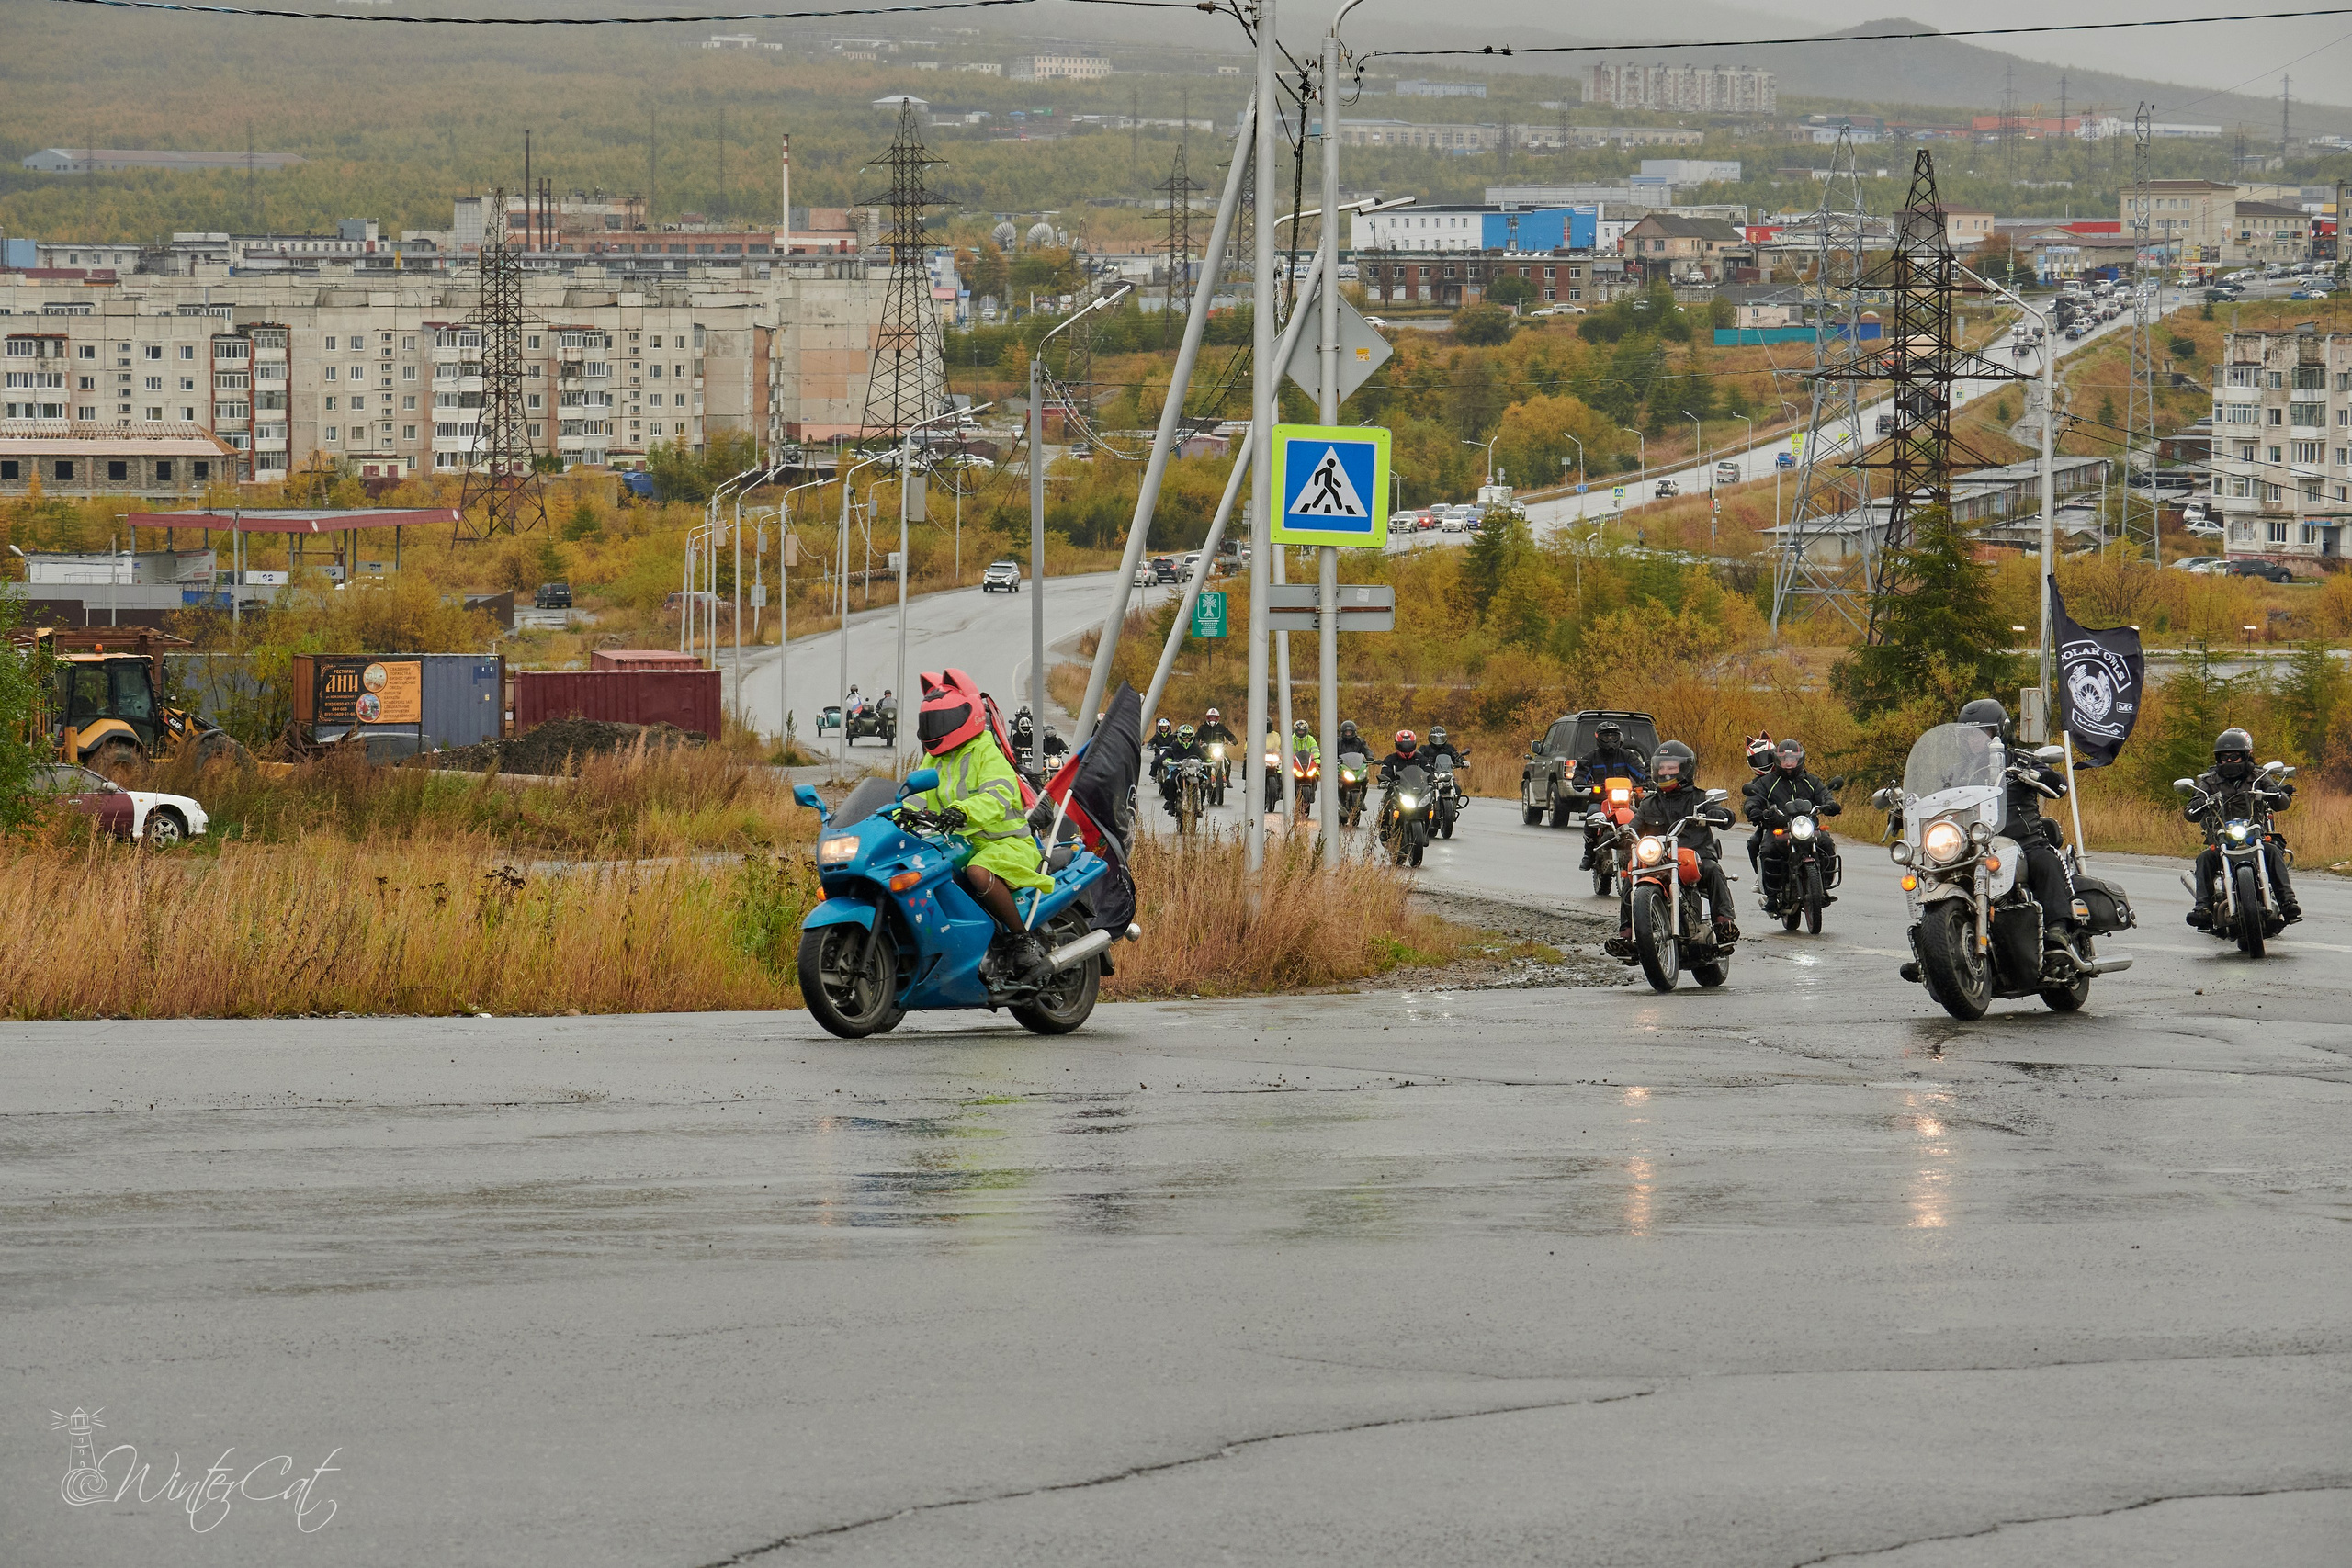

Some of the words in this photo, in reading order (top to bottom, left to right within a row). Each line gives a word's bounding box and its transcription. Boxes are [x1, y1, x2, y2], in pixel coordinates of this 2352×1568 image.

[262, 573, 274, 581] 92
[2102, 651, 2126, 682] OWLS
[325, 674, 359, 693] АНИ
